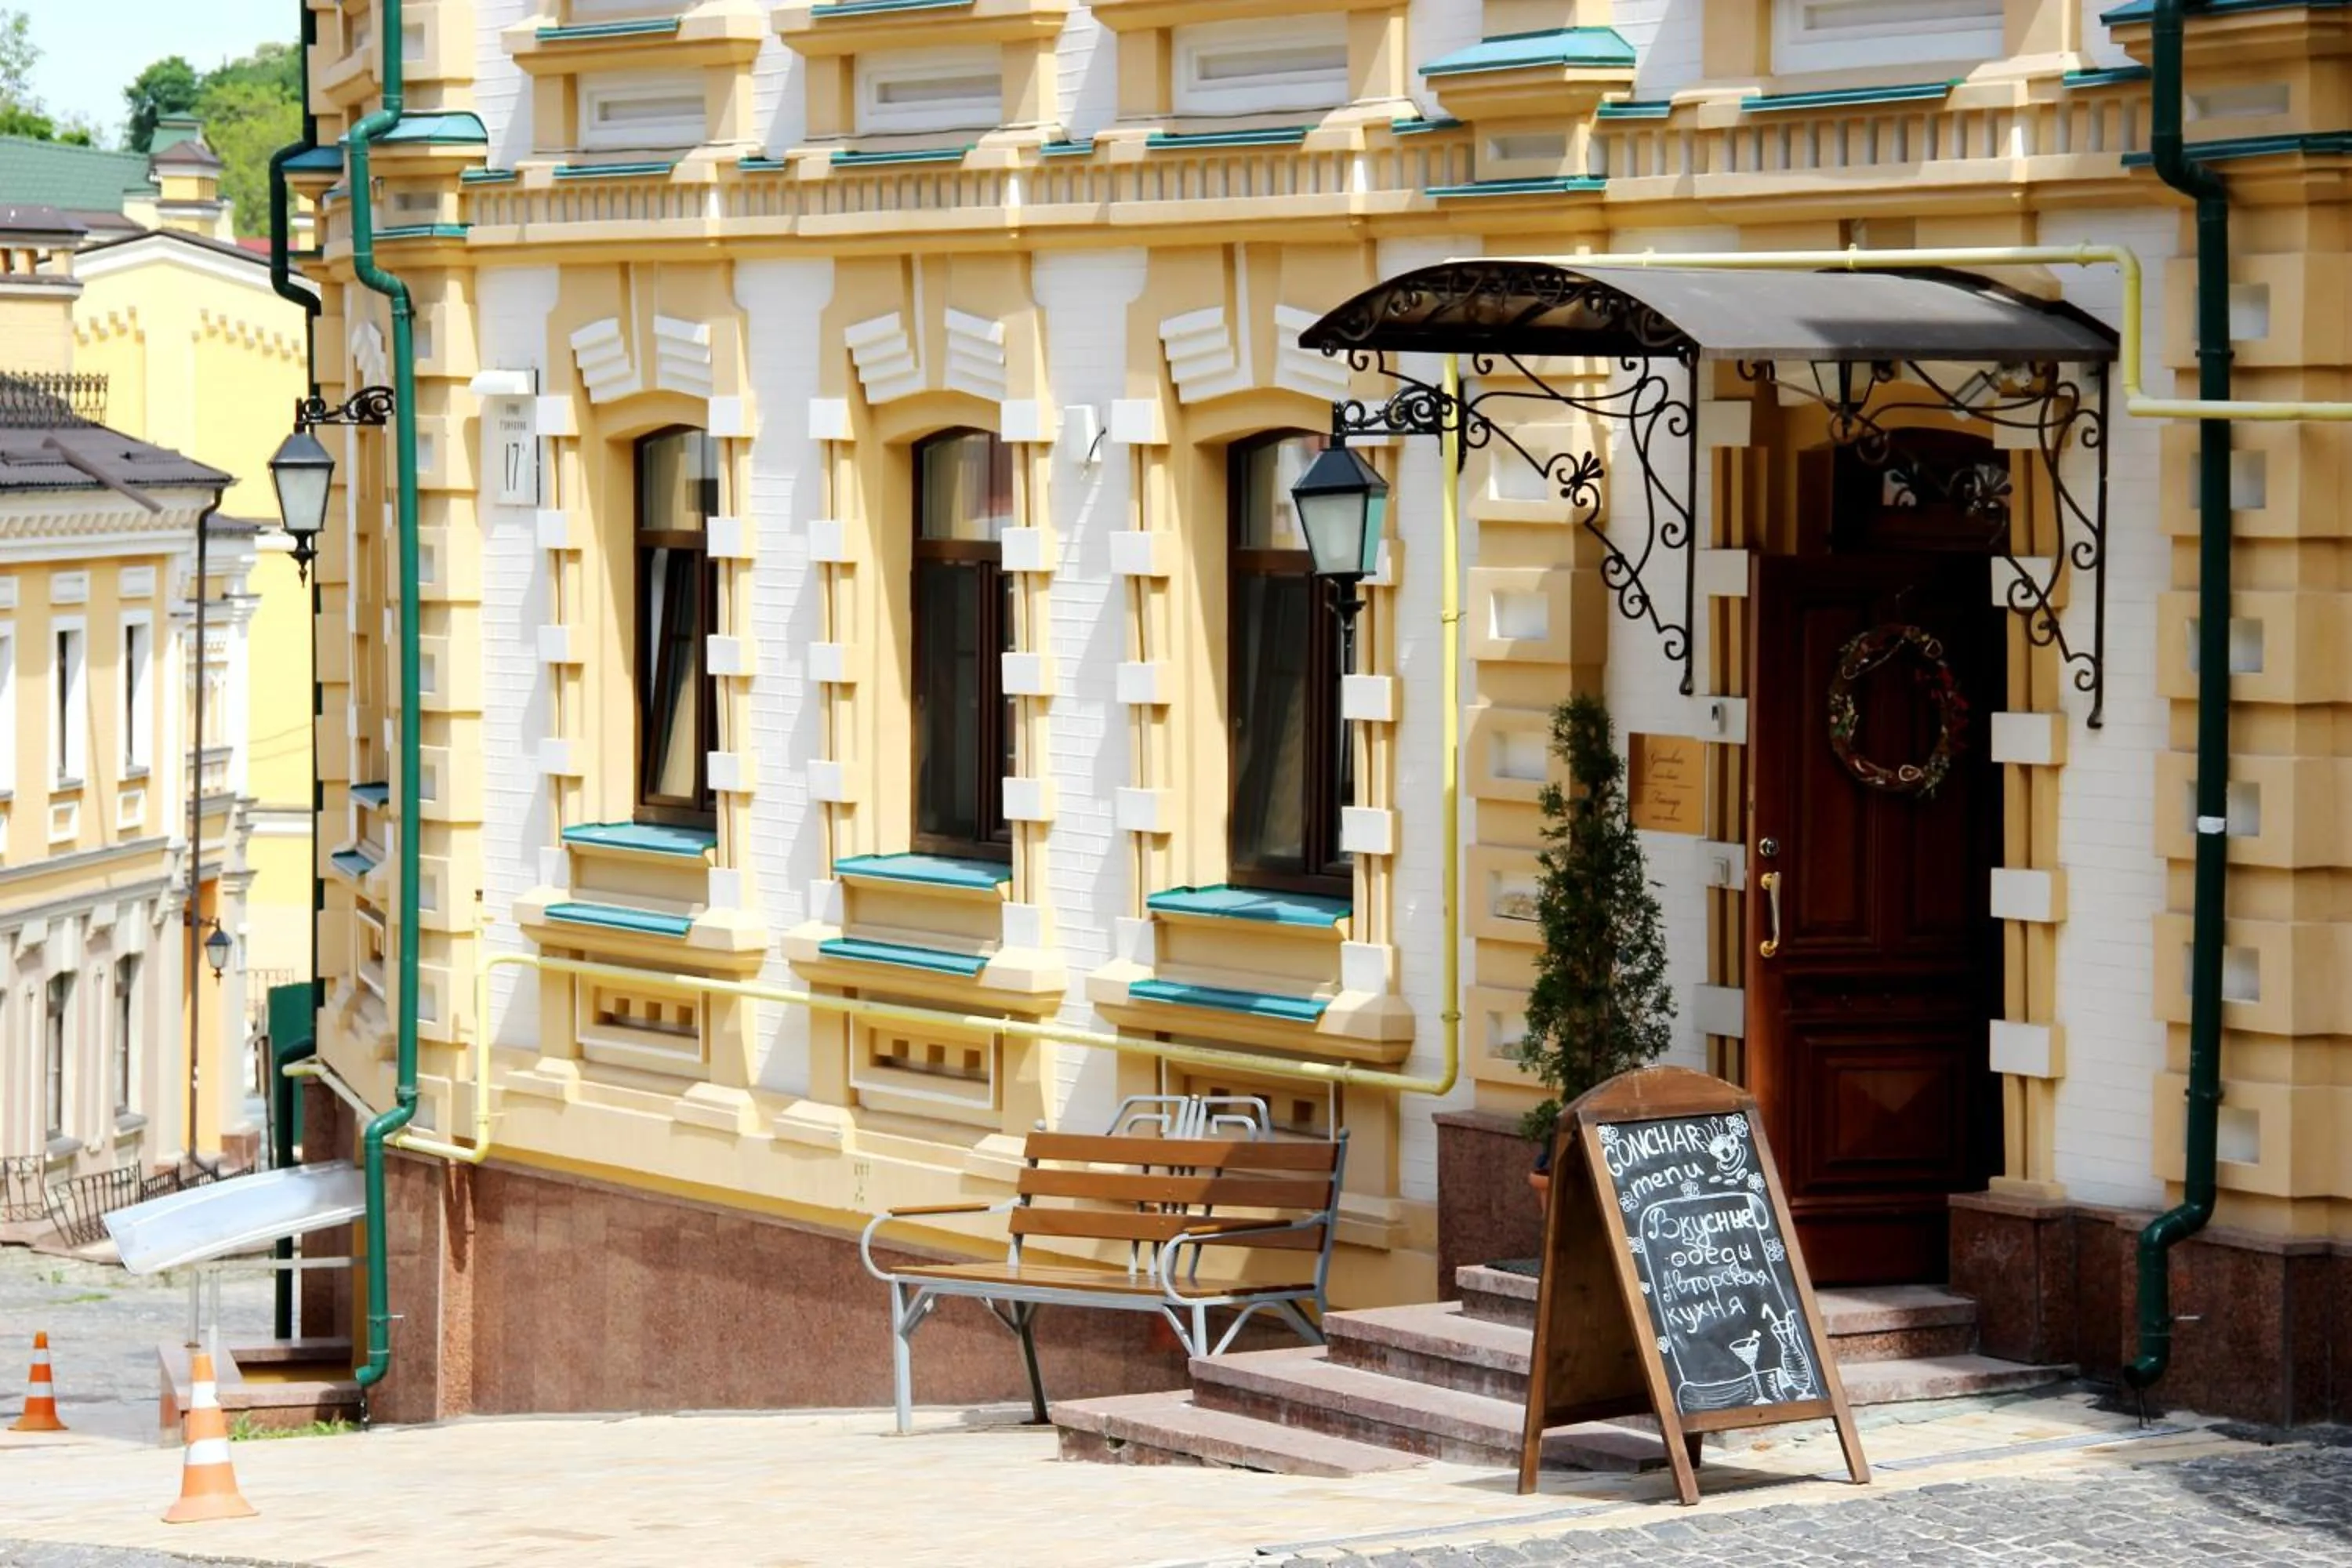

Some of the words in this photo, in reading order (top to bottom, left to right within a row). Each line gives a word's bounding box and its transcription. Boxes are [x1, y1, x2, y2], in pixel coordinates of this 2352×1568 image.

[1603, 1124, 1706, 1177] GONCHAR
[1631, 1162, 1705, 1200] menu
[1648, 1207, 1755, 1248] Вкусные
[1671, 1243, 1752, 1273] обеды
[1663, 1265, 1771, 1302] Авторская
[1665, 1296, 1746, 1334] кухня
